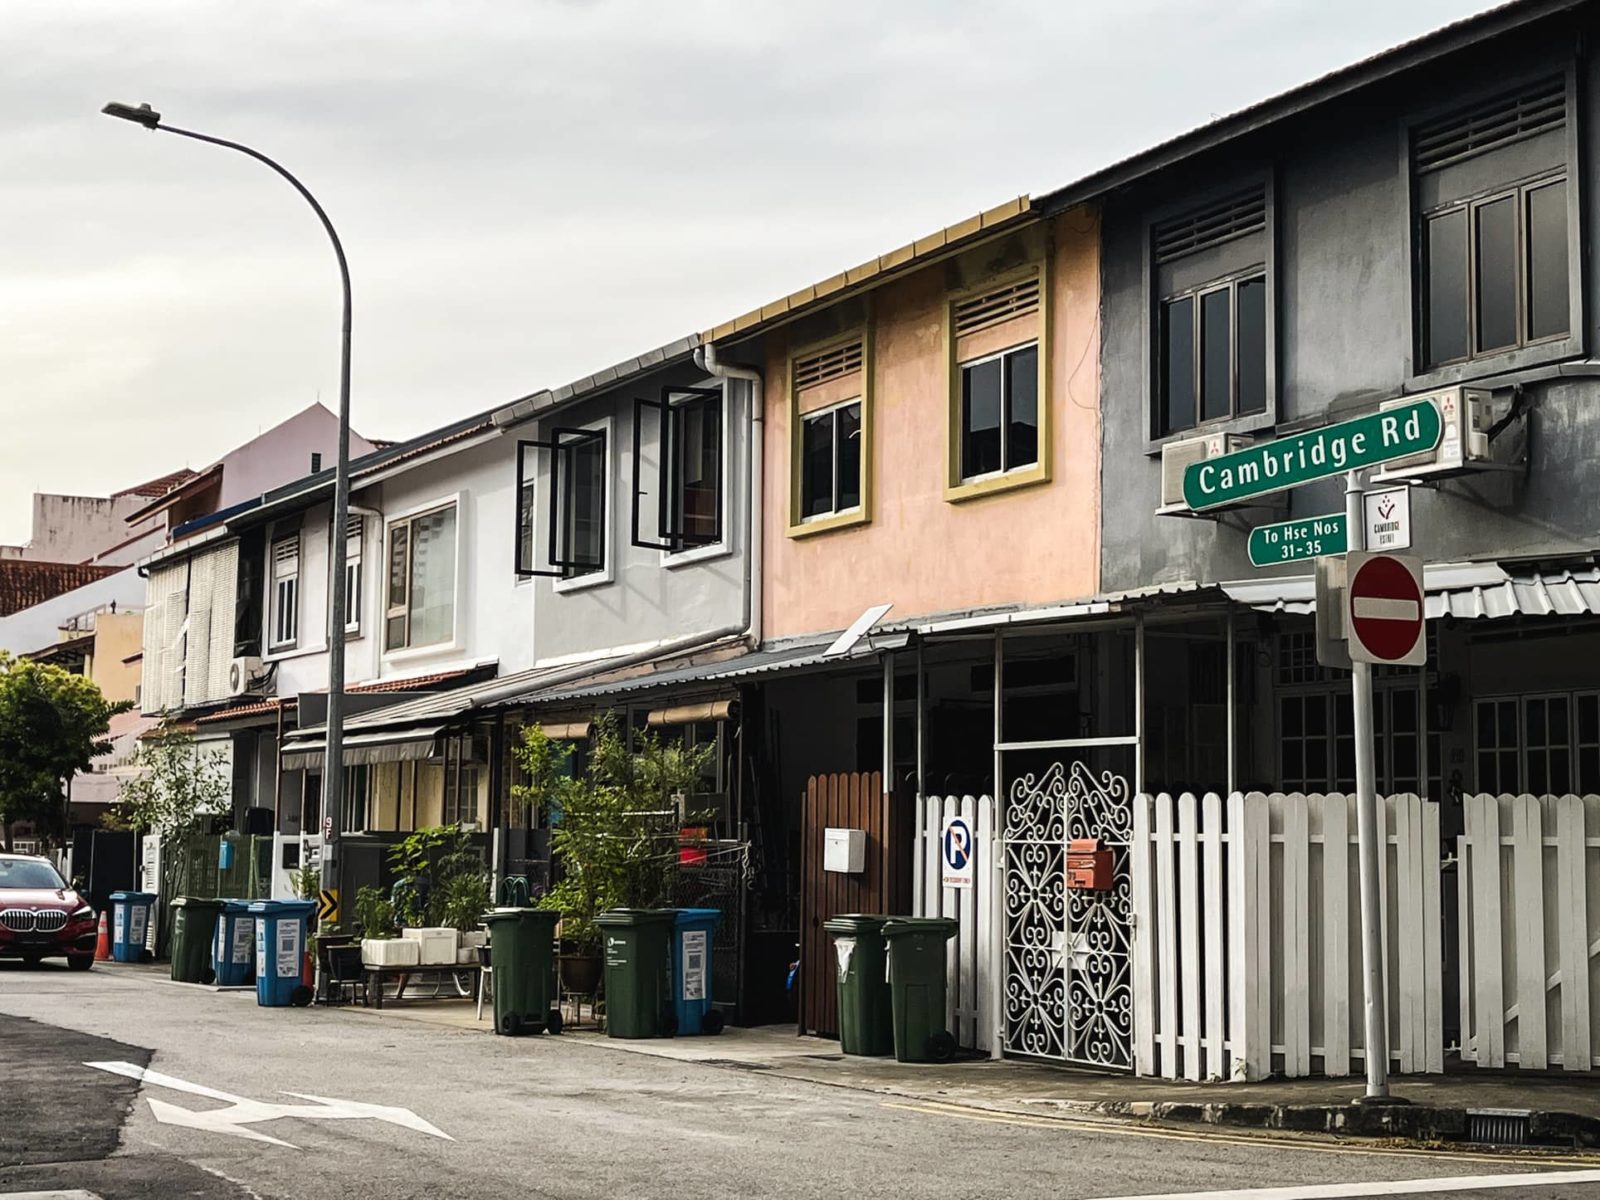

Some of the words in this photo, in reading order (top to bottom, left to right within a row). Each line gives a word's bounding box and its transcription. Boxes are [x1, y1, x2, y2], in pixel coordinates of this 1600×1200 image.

[1199, 432, 1366, 494] Cambridge
[1381, 410, 1421, 447] Rd
[1263, 529, 1278, 544] To
[1284, 526, 1308, 540] Hse
[1314, 520, 1339, 535] Nos
[1281, 540, 1322, 559] 31-35
[950, 826, 967, 864] P
